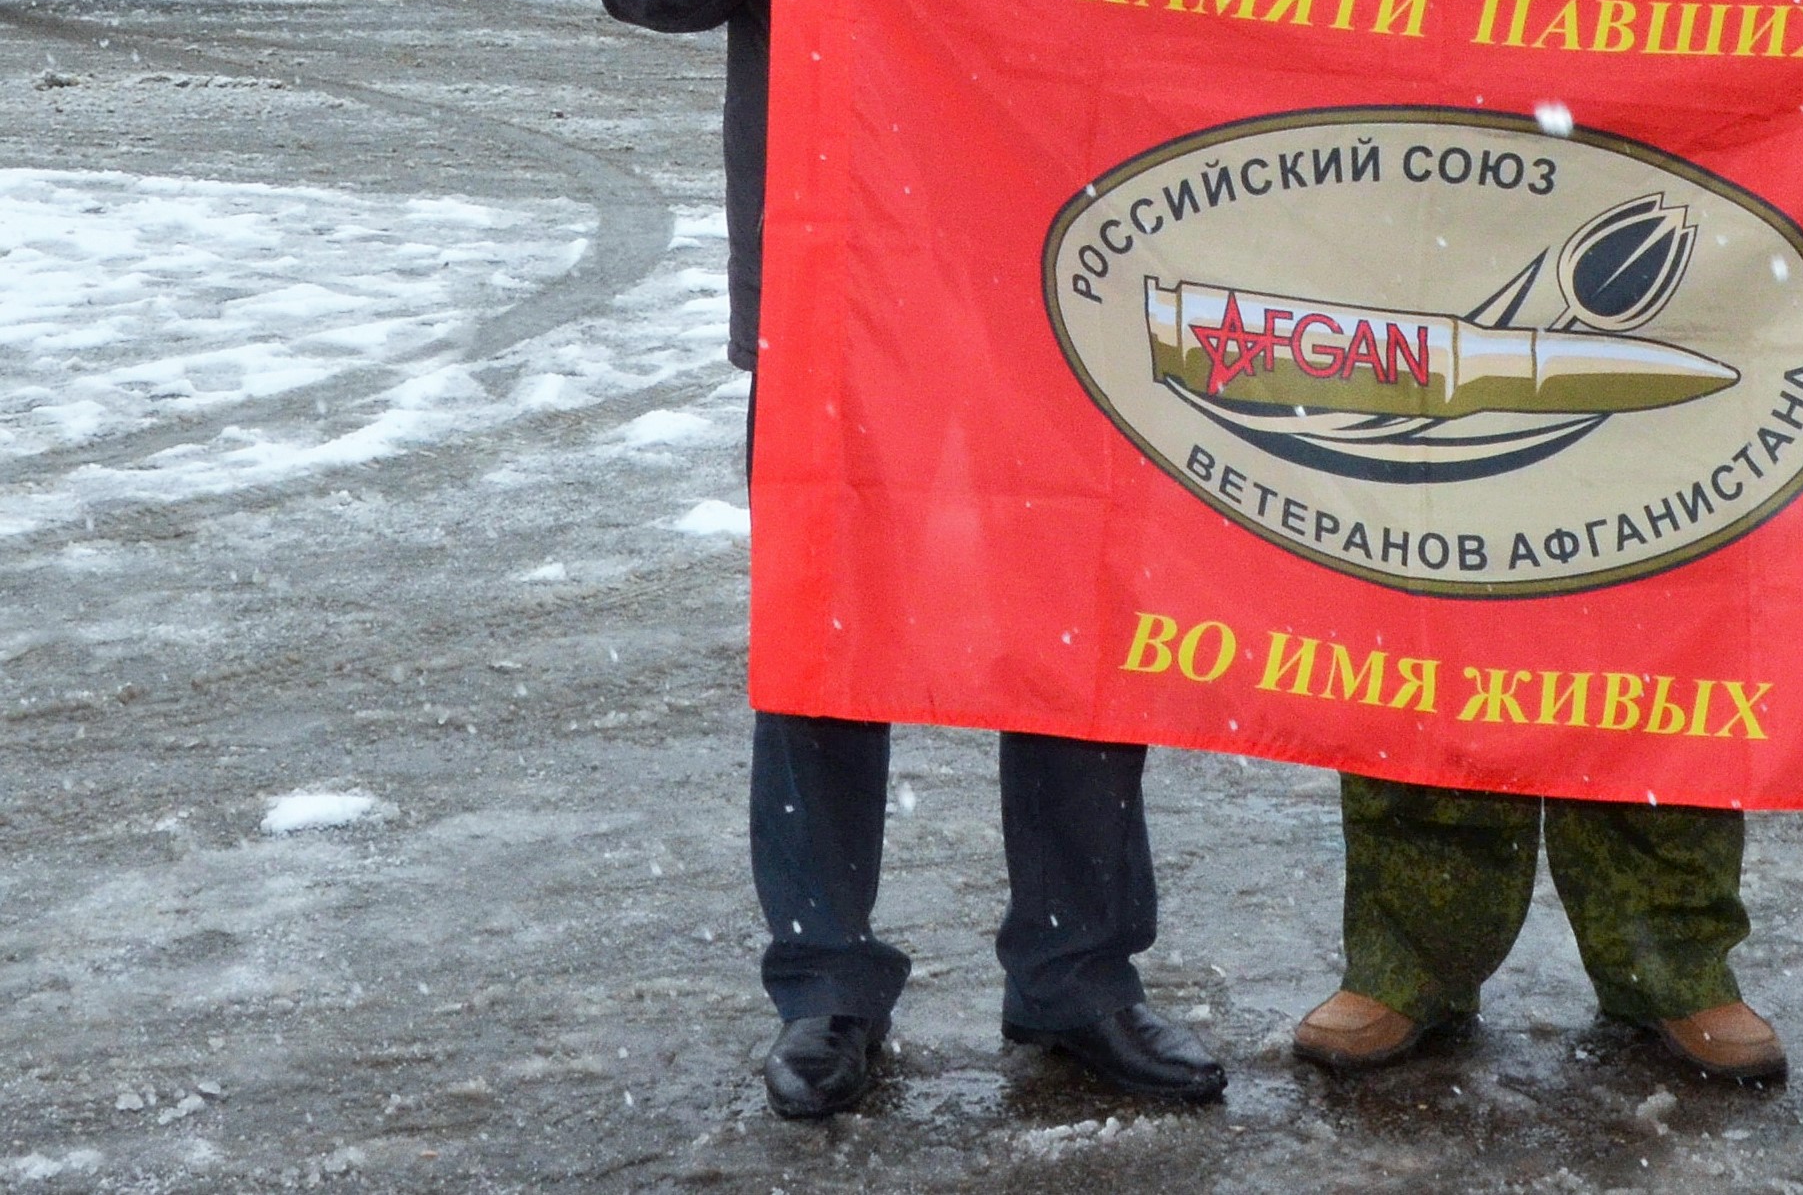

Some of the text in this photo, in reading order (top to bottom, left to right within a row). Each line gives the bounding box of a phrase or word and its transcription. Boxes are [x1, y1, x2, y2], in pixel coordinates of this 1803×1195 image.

[1072, 137, 1557, 304] РОССИЙСКИЙ СОЮЗ
[1187, 291, 1429, 397] AFGAN
[1186, 444, 1488, 571] ВЕТЕРАНОВ
[1120, 613, 1773, 739] ВО ИМЯ ЖИВЫХ
